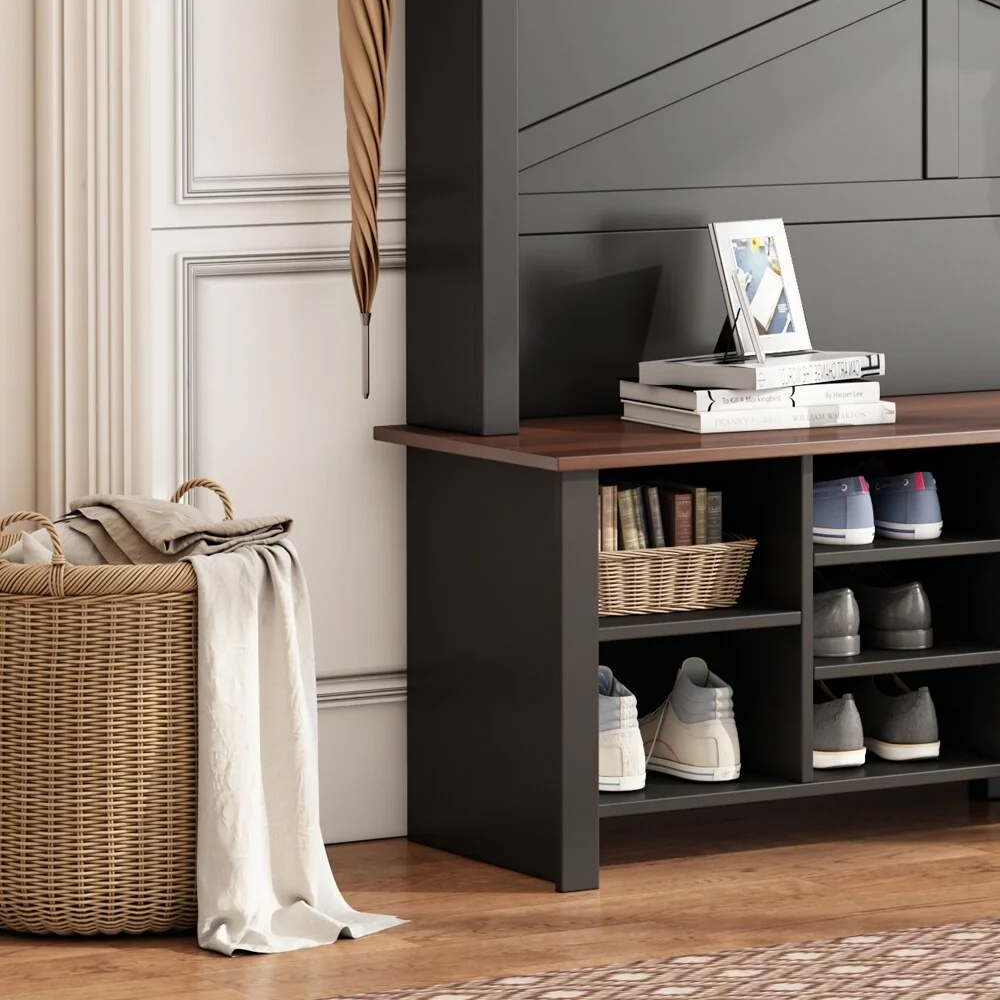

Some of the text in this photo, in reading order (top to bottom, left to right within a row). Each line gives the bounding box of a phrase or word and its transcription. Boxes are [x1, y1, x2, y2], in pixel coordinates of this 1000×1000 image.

[729, 396, 739, 404] Kill
[745, 395, 781, 405] Mockingbird
[824, 390, 864, 400] By Harper Lee
[792, 412, 867, 423] WILLIAM WHARTON
